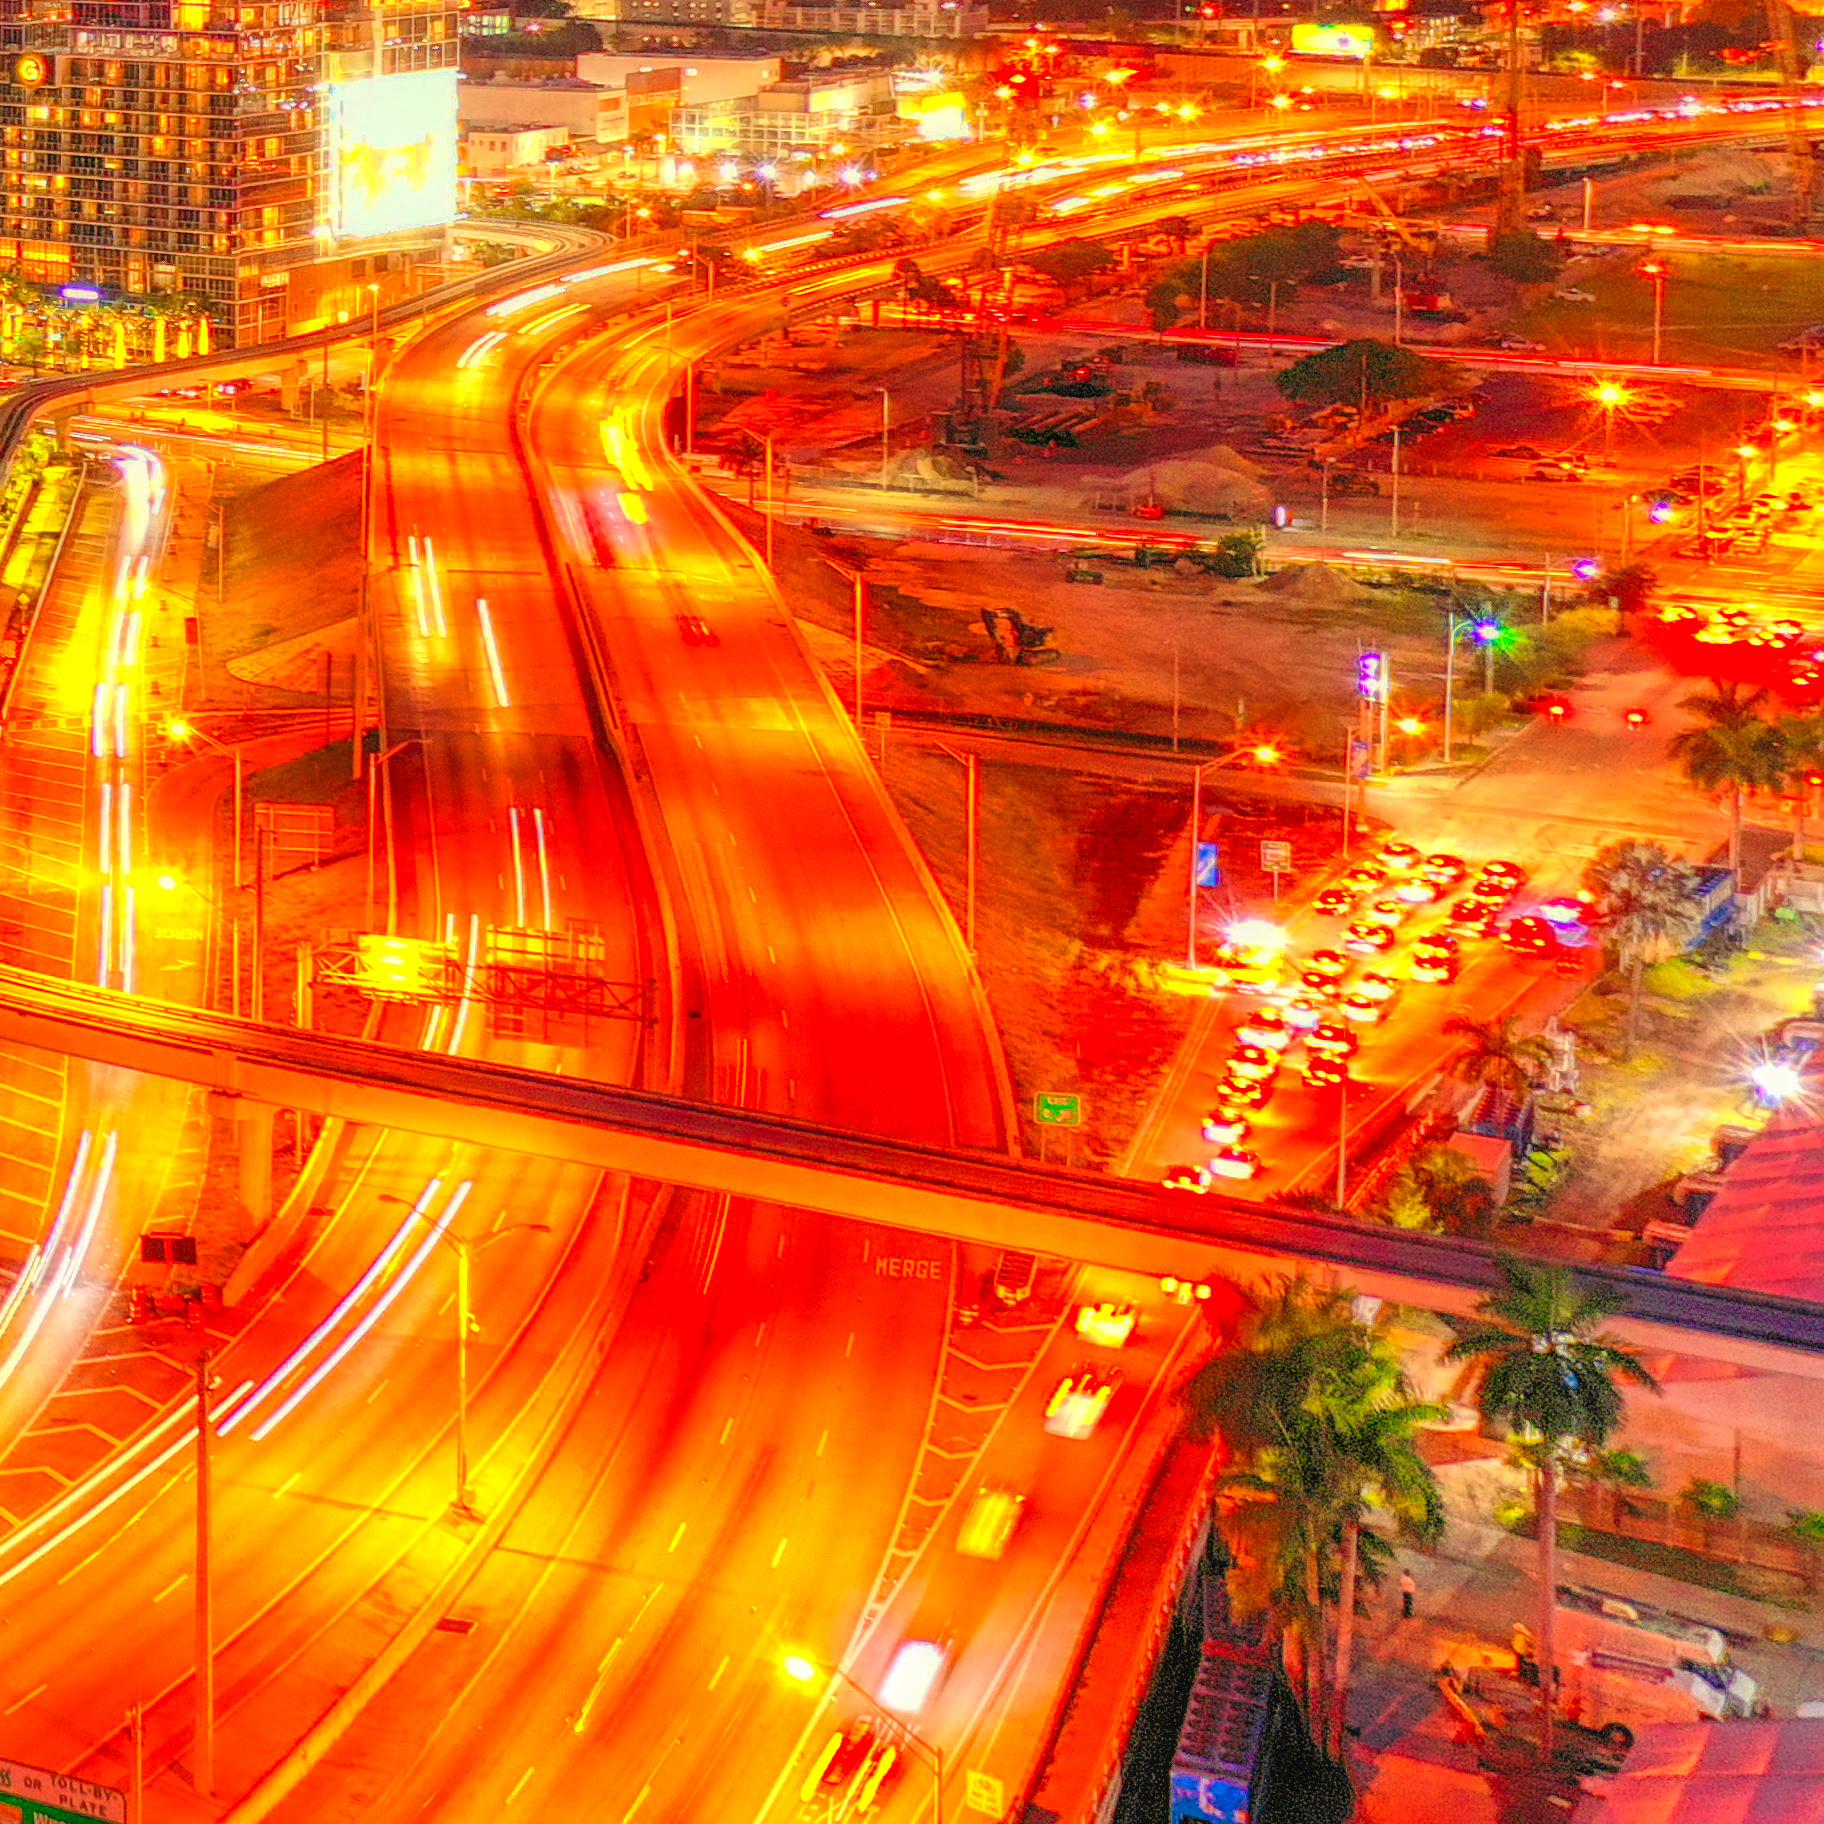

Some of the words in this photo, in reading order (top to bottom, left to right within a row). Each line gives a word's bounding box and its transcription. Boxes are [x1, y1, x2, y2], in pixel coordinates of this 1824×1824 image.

[875, 1256, 942, 1280] MERGE
[23, 1776, 43, 1792] OR
[58, 1793, 108, 1818] PLATE
